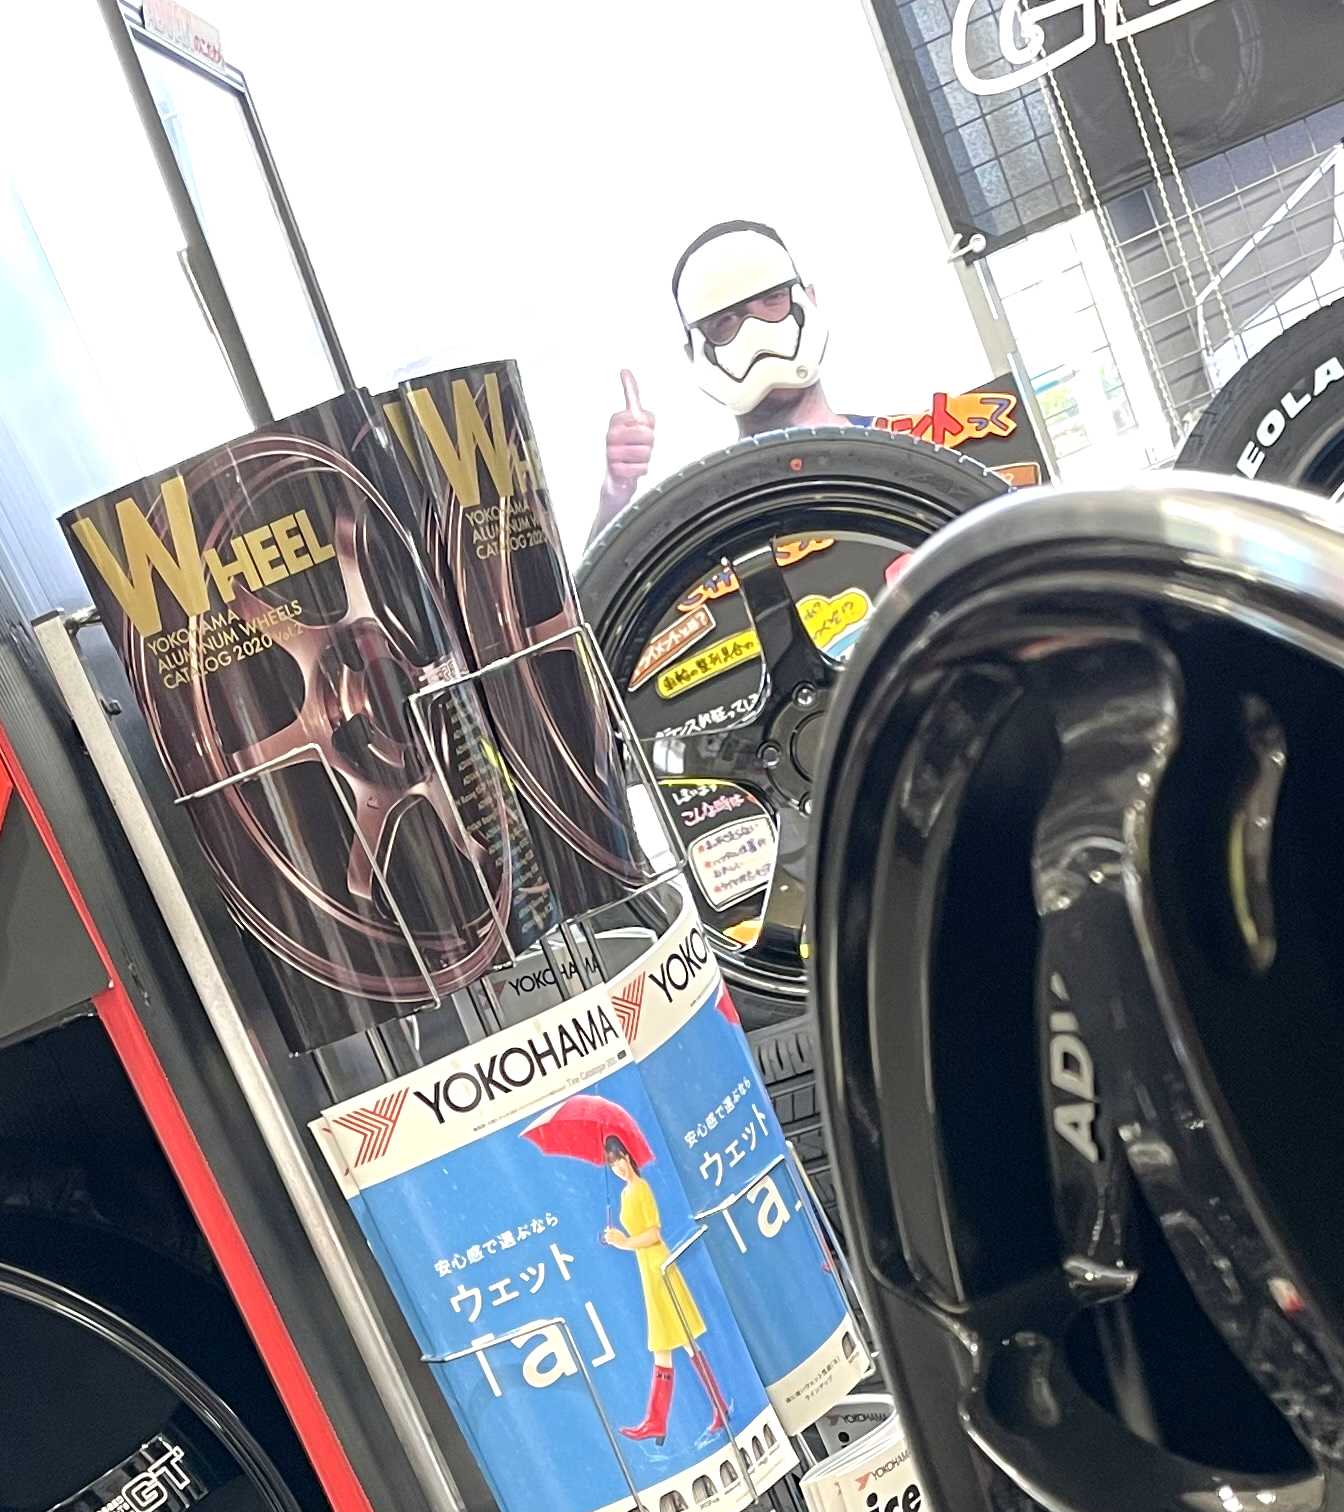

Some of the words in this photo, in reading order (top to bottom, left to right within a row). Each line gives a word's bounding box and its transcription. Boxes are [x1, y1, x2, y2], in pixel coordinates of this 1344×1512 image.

[158, 627, 240, 674] ALUMNUM
[239, 599, 303, 636] WHEELS
[233, 633, 273, 661] 2020
[413, 1005, 619, 1125] YOKOHAMA
[434, 1212, 559, 1278] 安心感で選ぶなら
[450, 1243, 574, 1323] ウェット
